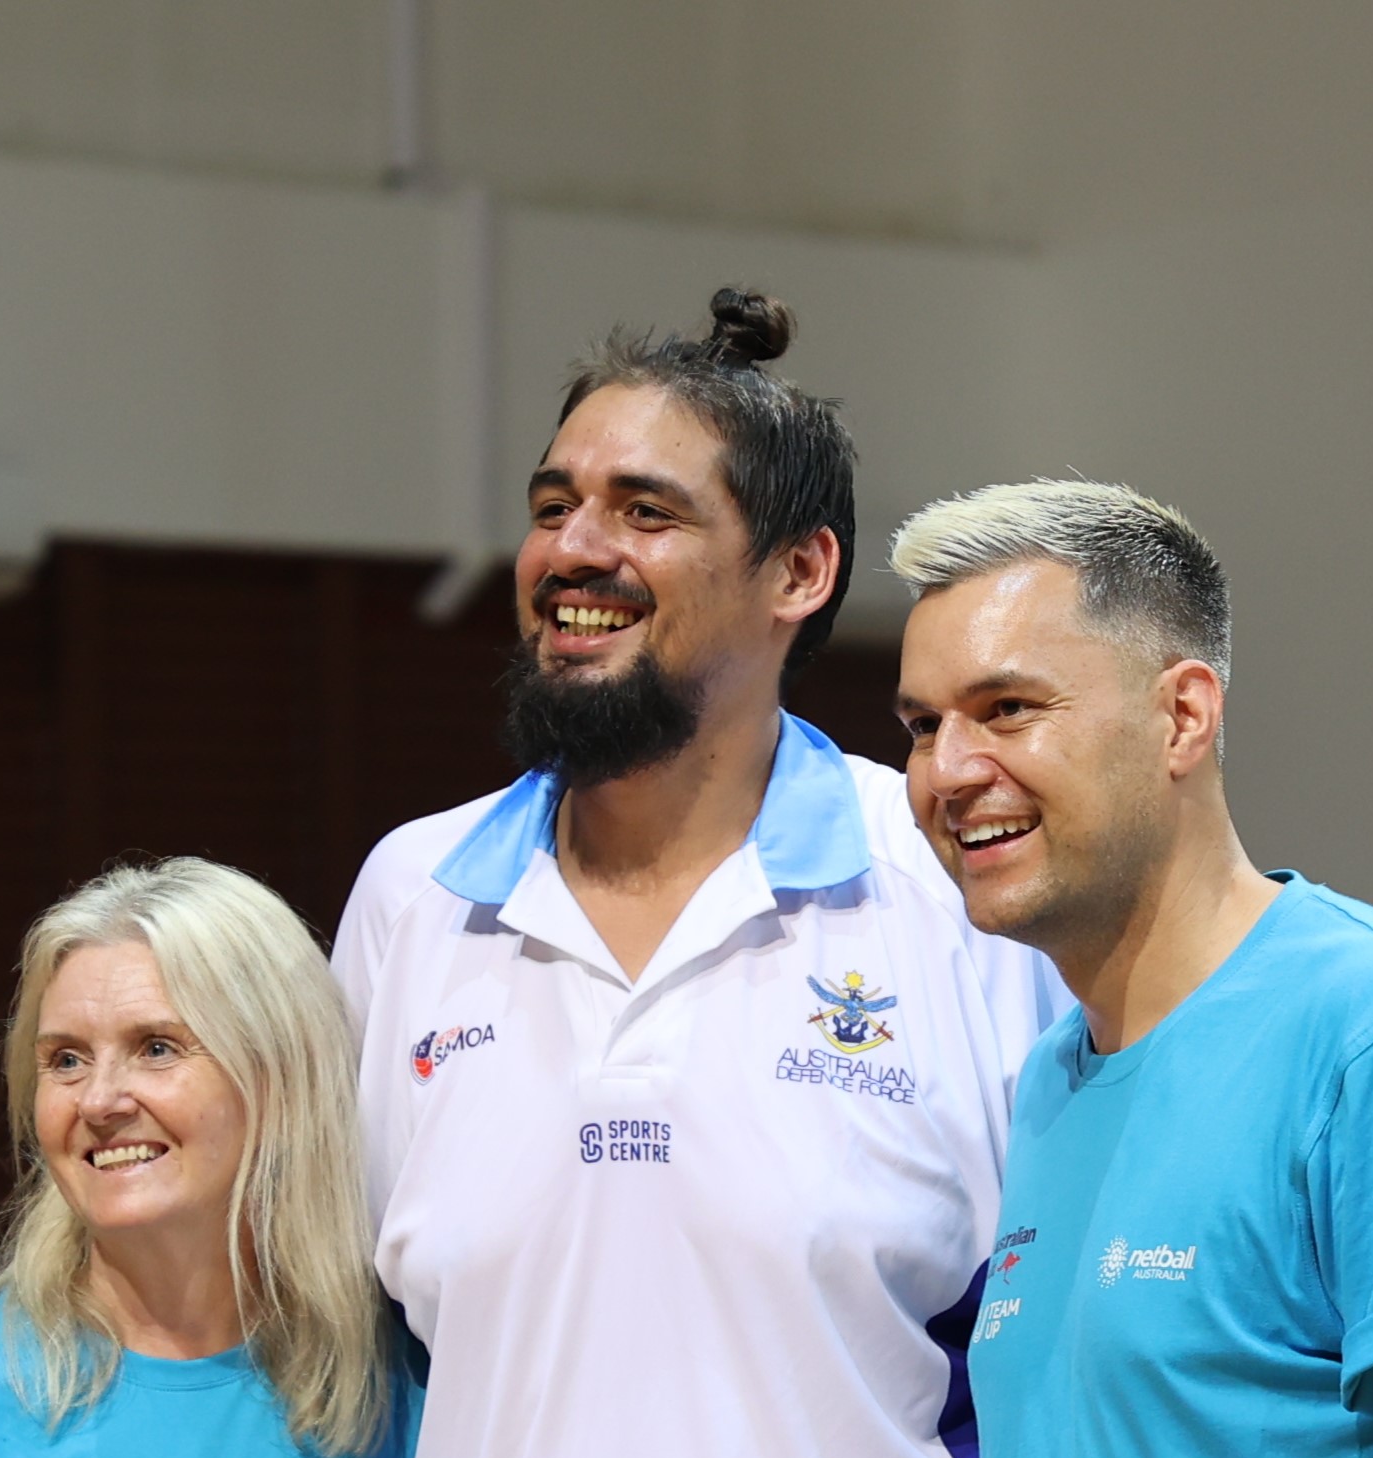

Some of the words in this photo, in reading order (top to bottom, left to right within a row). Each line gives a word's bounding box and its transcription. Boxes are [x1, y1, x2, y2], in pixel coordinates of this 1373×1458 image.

[777, 1047, 915, 1089] AUSTRALIAN
[776, 1065, 854, 1093] DEFENCE
[859, 1079, 915, 1105] FORCE
[608, 1120, 671, 1141] SPORTS
[609, 1142, 670, 1163] CENTRE
[994, 1226, 1037, 1255] stralian
[1127, 1243, 1196, 1269] netball
[1132, 1268, 1186, 1281] AUSTRALIA
[988, 1298, 1021, 1320] TEAM
[985, 1320, 1001, 1340] UP
